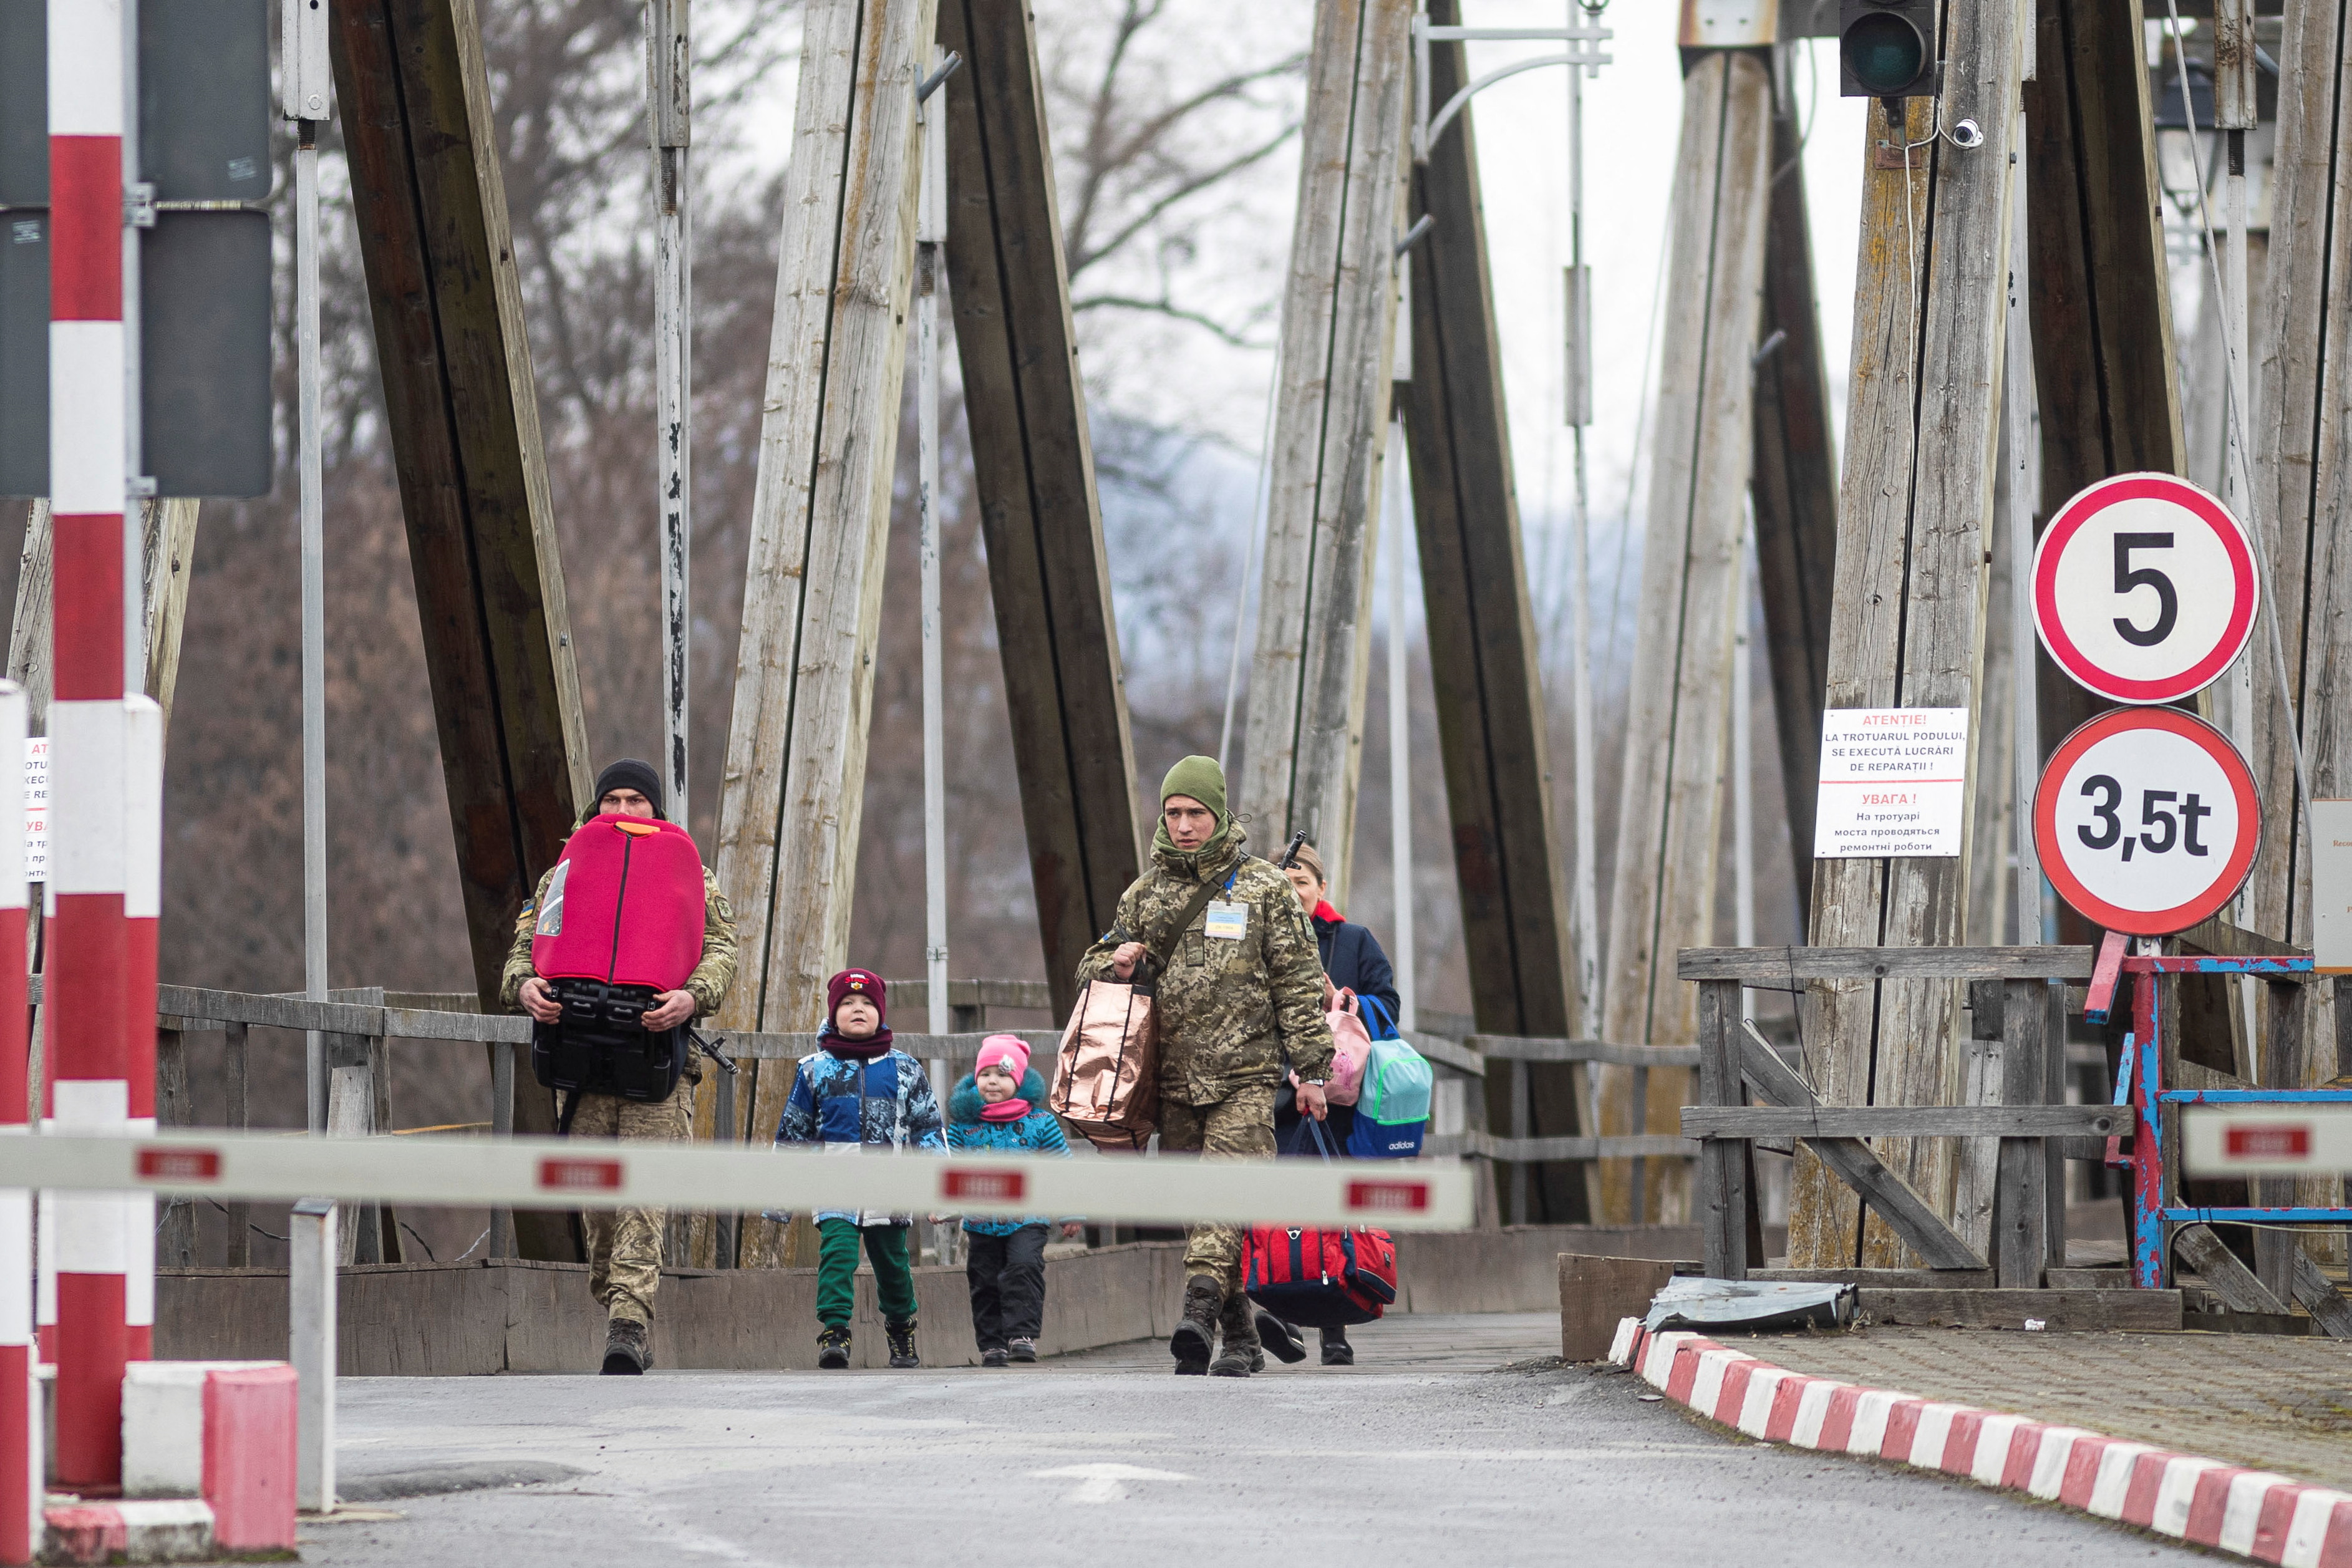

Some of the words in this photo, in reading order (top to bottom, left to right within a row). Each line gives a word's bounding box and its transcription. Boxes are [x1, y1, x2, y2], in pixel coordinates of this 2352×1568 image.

[2113, 531, 2178, 647] 5
[1825, 733, 1839, 742] LA
[1842, 732, 1910, 742] TROTUARUL
[1913, 732, 1965, 742] PODULUI,
[1832, 748, 1846, 757] SE
[1850, 763, 1864, 772] DE
[1862, 793, 1908, 805] УВАГА
[1856, 813, 1870, 821] На
[1874, 811, 1920, 822] тротуарі
[2077, 774, 2212, 862] 3,5t
[1870, 828, 1940, 838] проводяться
[1840, 842, 1890, 853] ремонтні
[1894, 842, 1932, 852] роботи
[1388, 1141, 1415, 1150] adidas
